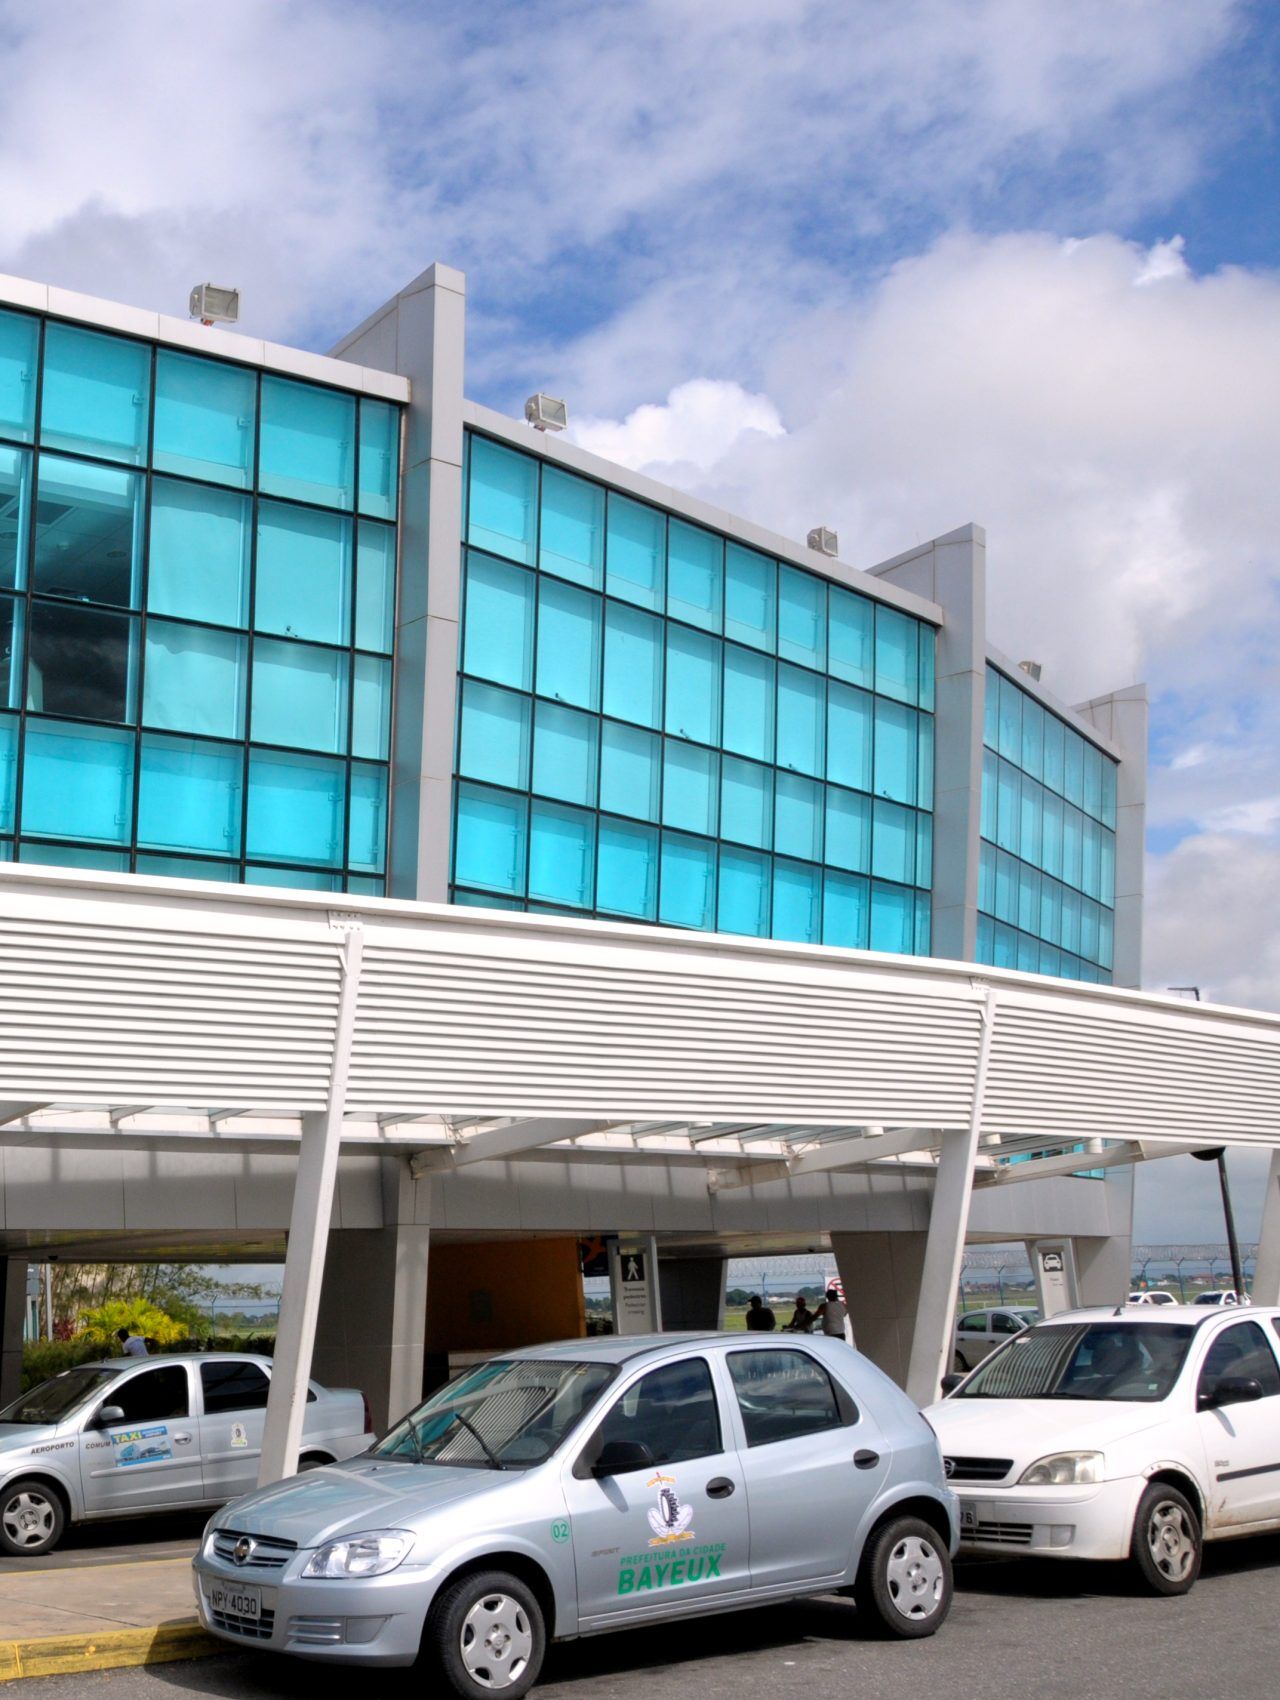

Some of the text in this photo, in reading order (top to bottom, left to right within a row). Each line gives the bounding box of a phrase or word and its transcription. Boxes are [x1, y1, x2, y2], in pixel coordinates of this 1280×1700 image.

[113, 1431, 143, 1445] TAXI
[31, 1441, 111, 1455] AEROPORTO COMUM
[553, 1523, 568, 1538] 02
[620, 1543, 727, 1566] PREFEITURA DA CIDADE
[617, 1554, 723, 1595] BAYEUX
